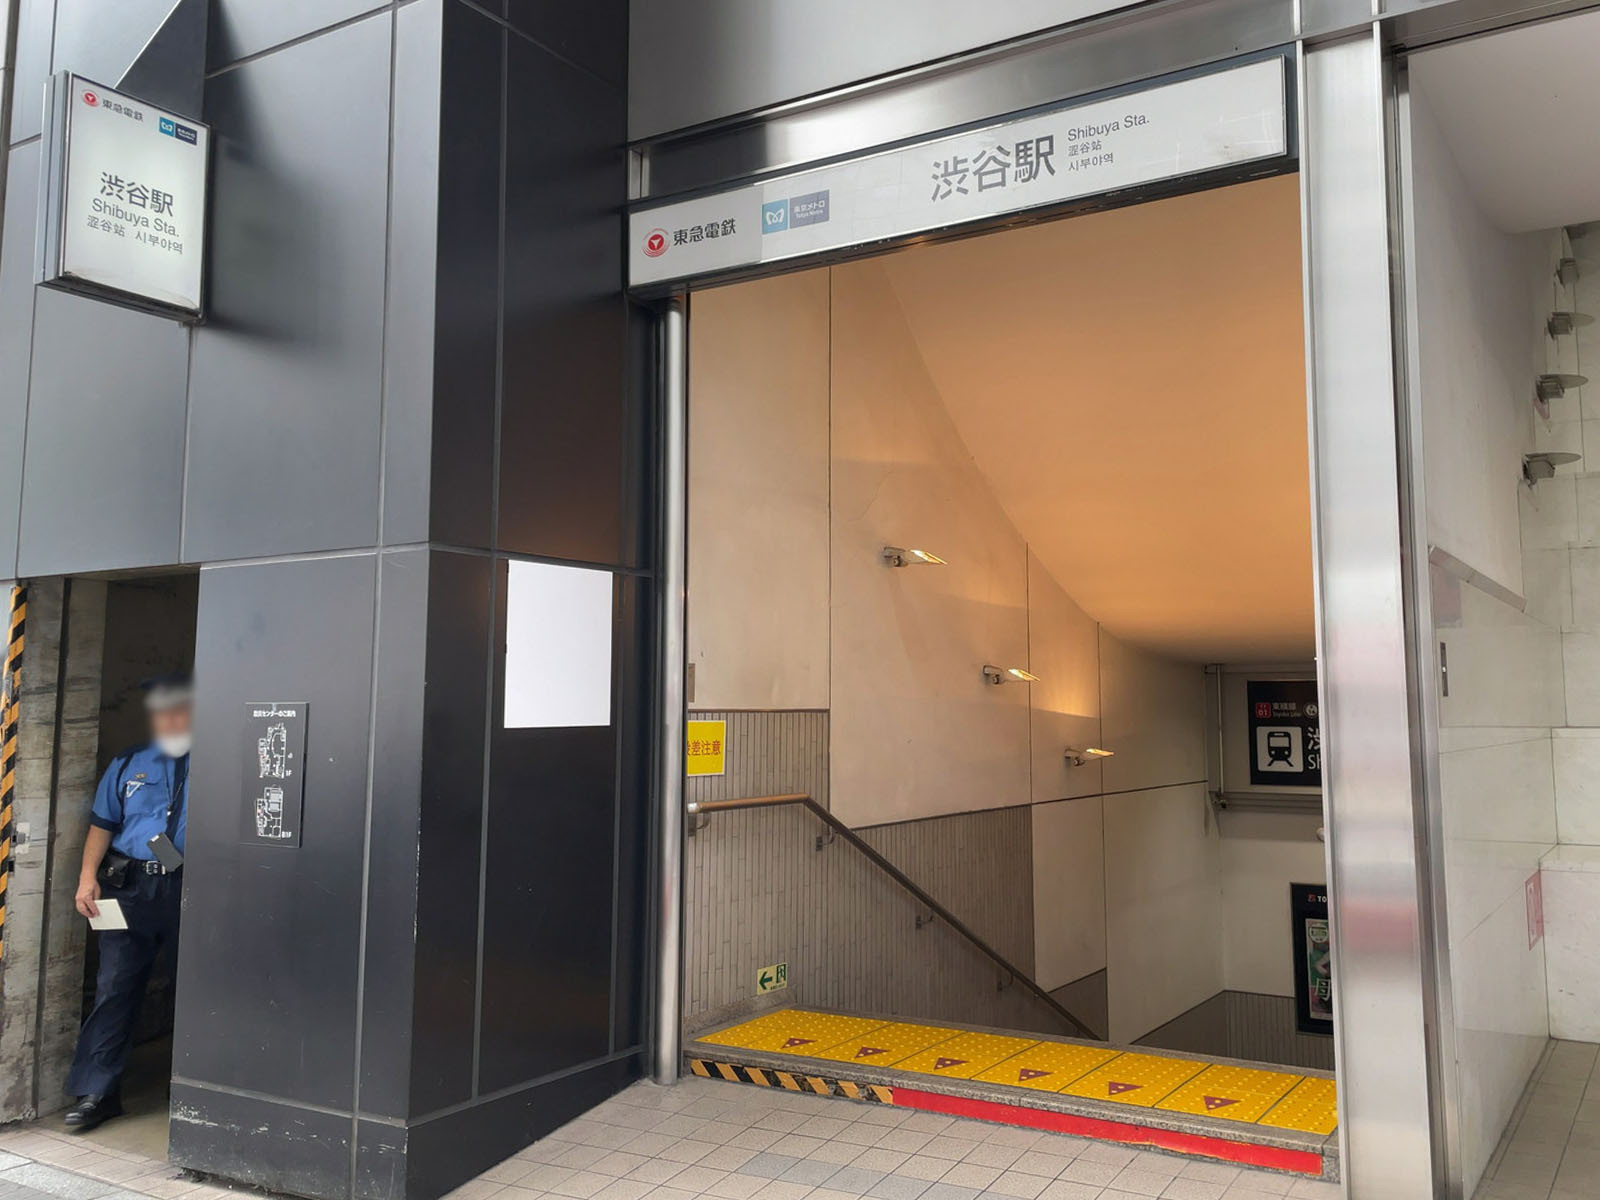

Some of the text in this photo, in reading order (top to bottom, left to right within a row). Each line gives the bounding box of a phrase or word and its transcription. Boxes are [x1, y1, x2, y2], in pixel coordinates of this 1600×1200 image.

[1067, 114, 1150, 142] Shibuya Sta.
[931, 135, 1056, 203] 渋谷駅
[1068, 152, 1114, 172] 시부야역
[100, 171, 174, 218] 渋谷駅
[92, 197, 180, 238] Shibuya Sta.
[134, 230, 183, 255] 시부야역
[672, 218, 737, 247] 東急電鉄
